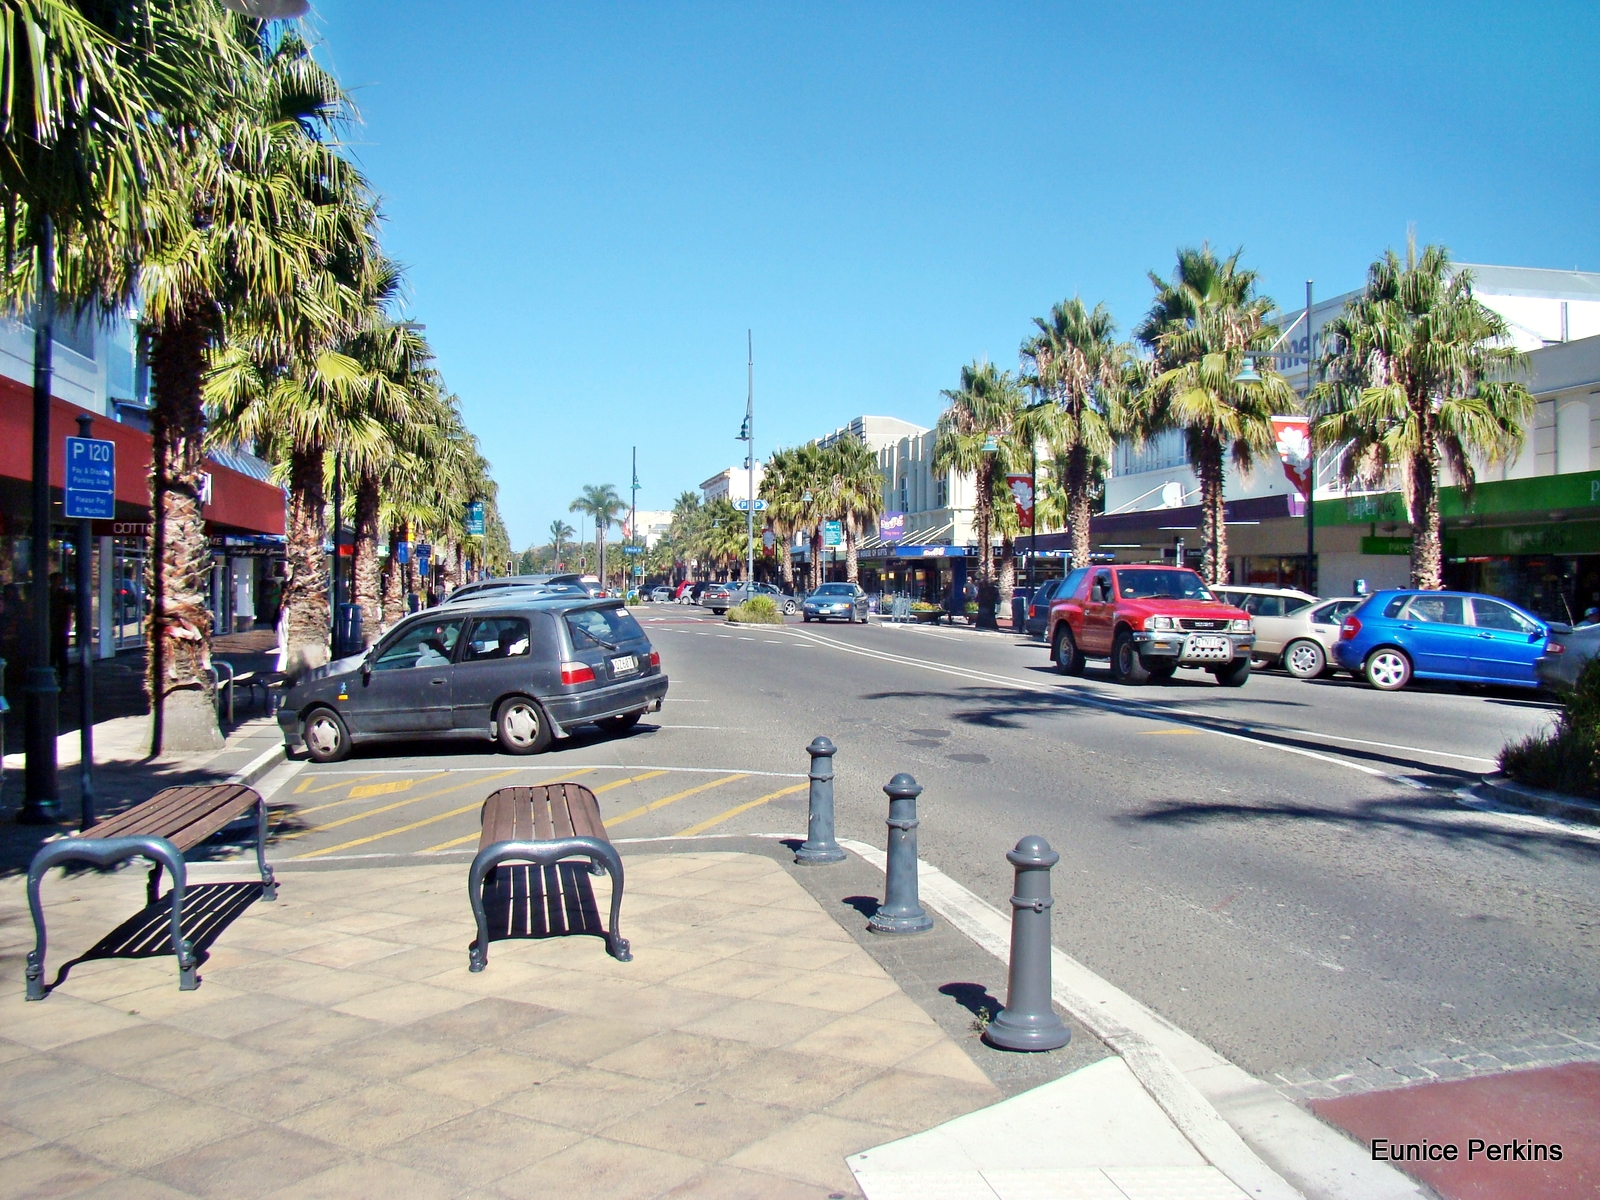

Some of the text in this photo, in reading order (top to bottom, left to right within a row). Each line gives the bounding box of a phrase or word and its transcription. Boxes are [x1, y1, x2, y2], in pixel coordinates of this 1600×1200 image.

[73, 442, 110, 462] P 120
[72, 466, 82, 475] Pay
[90, 467, 110, 477] Display
[73, 476, 110, 486] Parking Area
[75, 496, 106, 505] Please Pay
[84, 507, 106, 515] Machine
